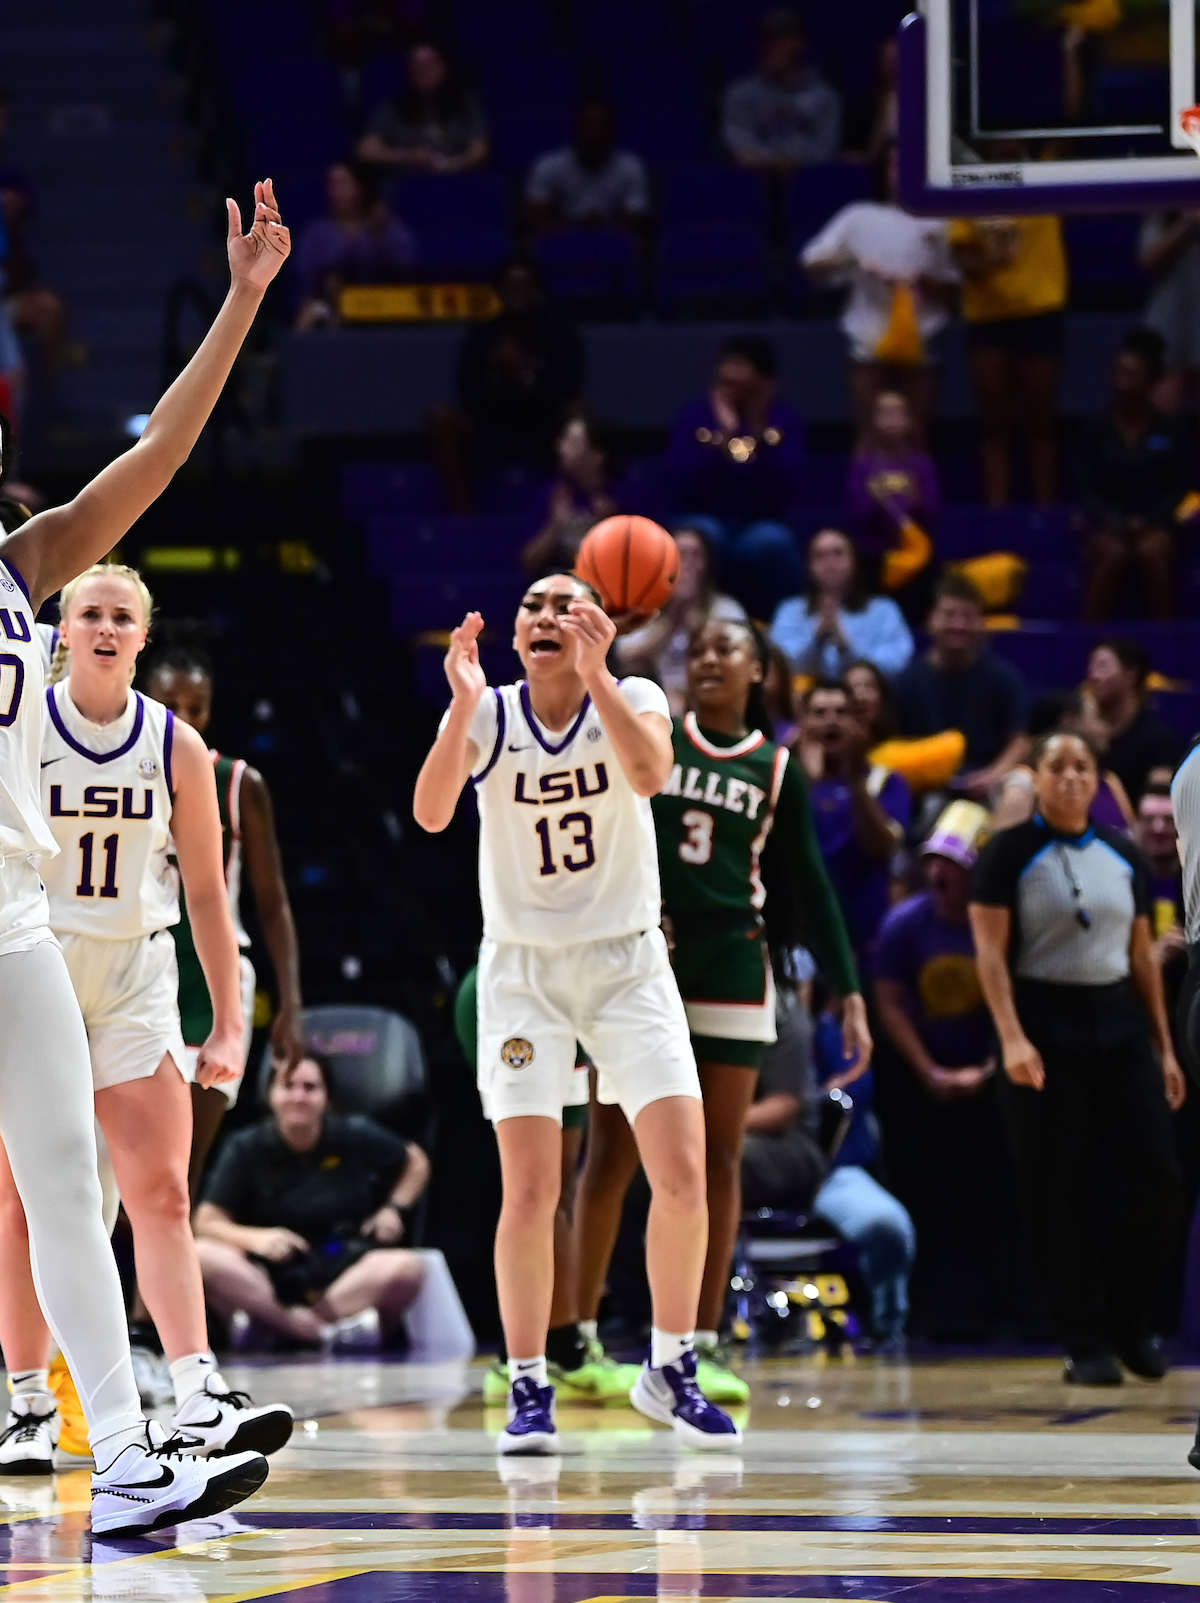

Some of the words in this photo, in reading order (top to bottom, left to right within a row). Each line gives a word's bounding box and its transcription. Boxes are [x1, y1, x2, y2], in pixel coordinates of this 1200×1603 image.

[50, 785, 153, 819] LSU
[514, 762, 609, 805] LSU
[661, 763, 767, 820] ALLEY
[76, 832, 120, 898] 11
[535, 812, 596, 875] 13
[677, 808, 716, 866] 3
